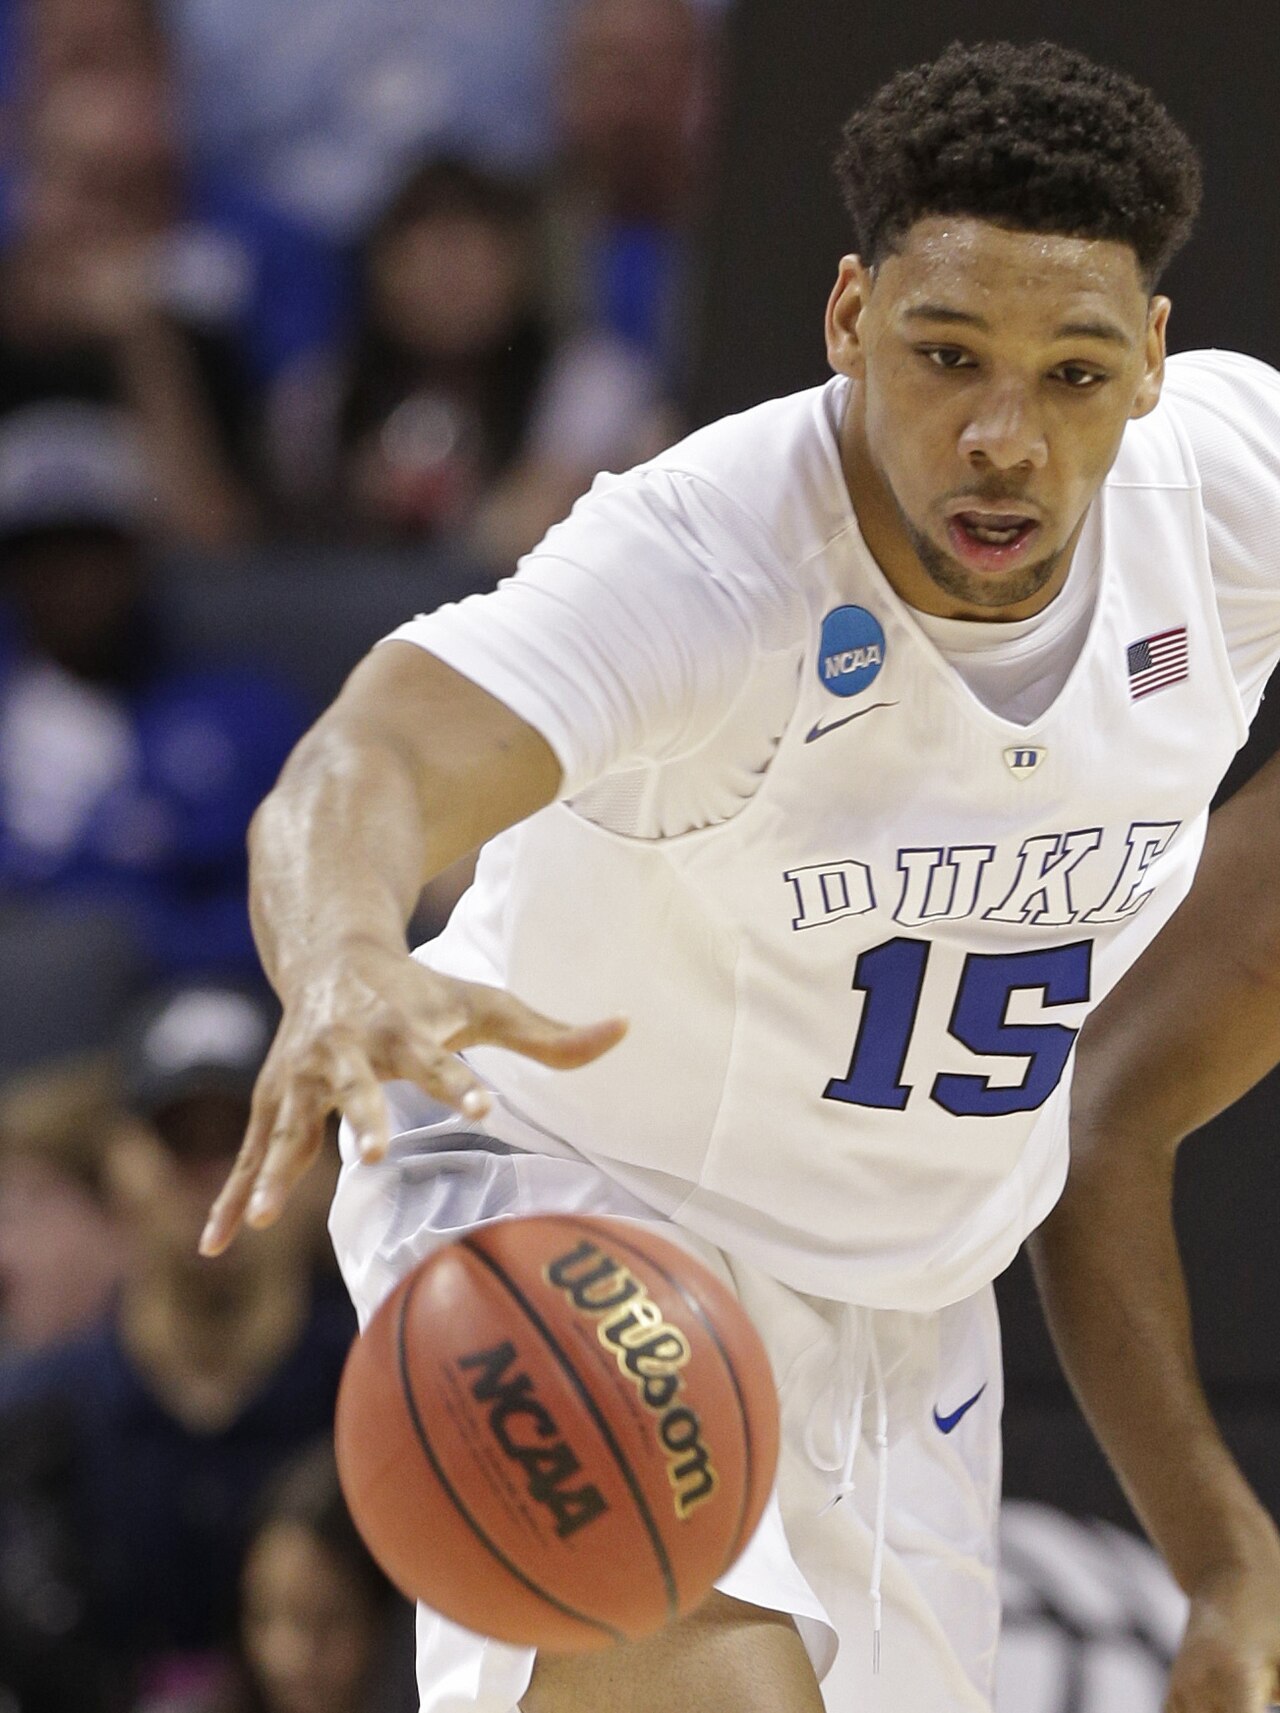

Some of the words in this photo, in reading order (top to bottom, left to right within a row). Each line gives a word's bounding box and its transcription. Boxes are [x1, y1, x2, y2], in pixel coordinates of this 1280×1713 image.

[824, 644, 883, 680] NCAA
[1010, 751, 1038, 768] D
[783, 820, 1183, 931] DUKE
[821, 936, 1094, 1117] 15
[458, 1341, 611, 1540] NCAA
[541, 1239, 719, 1521] Wilson
